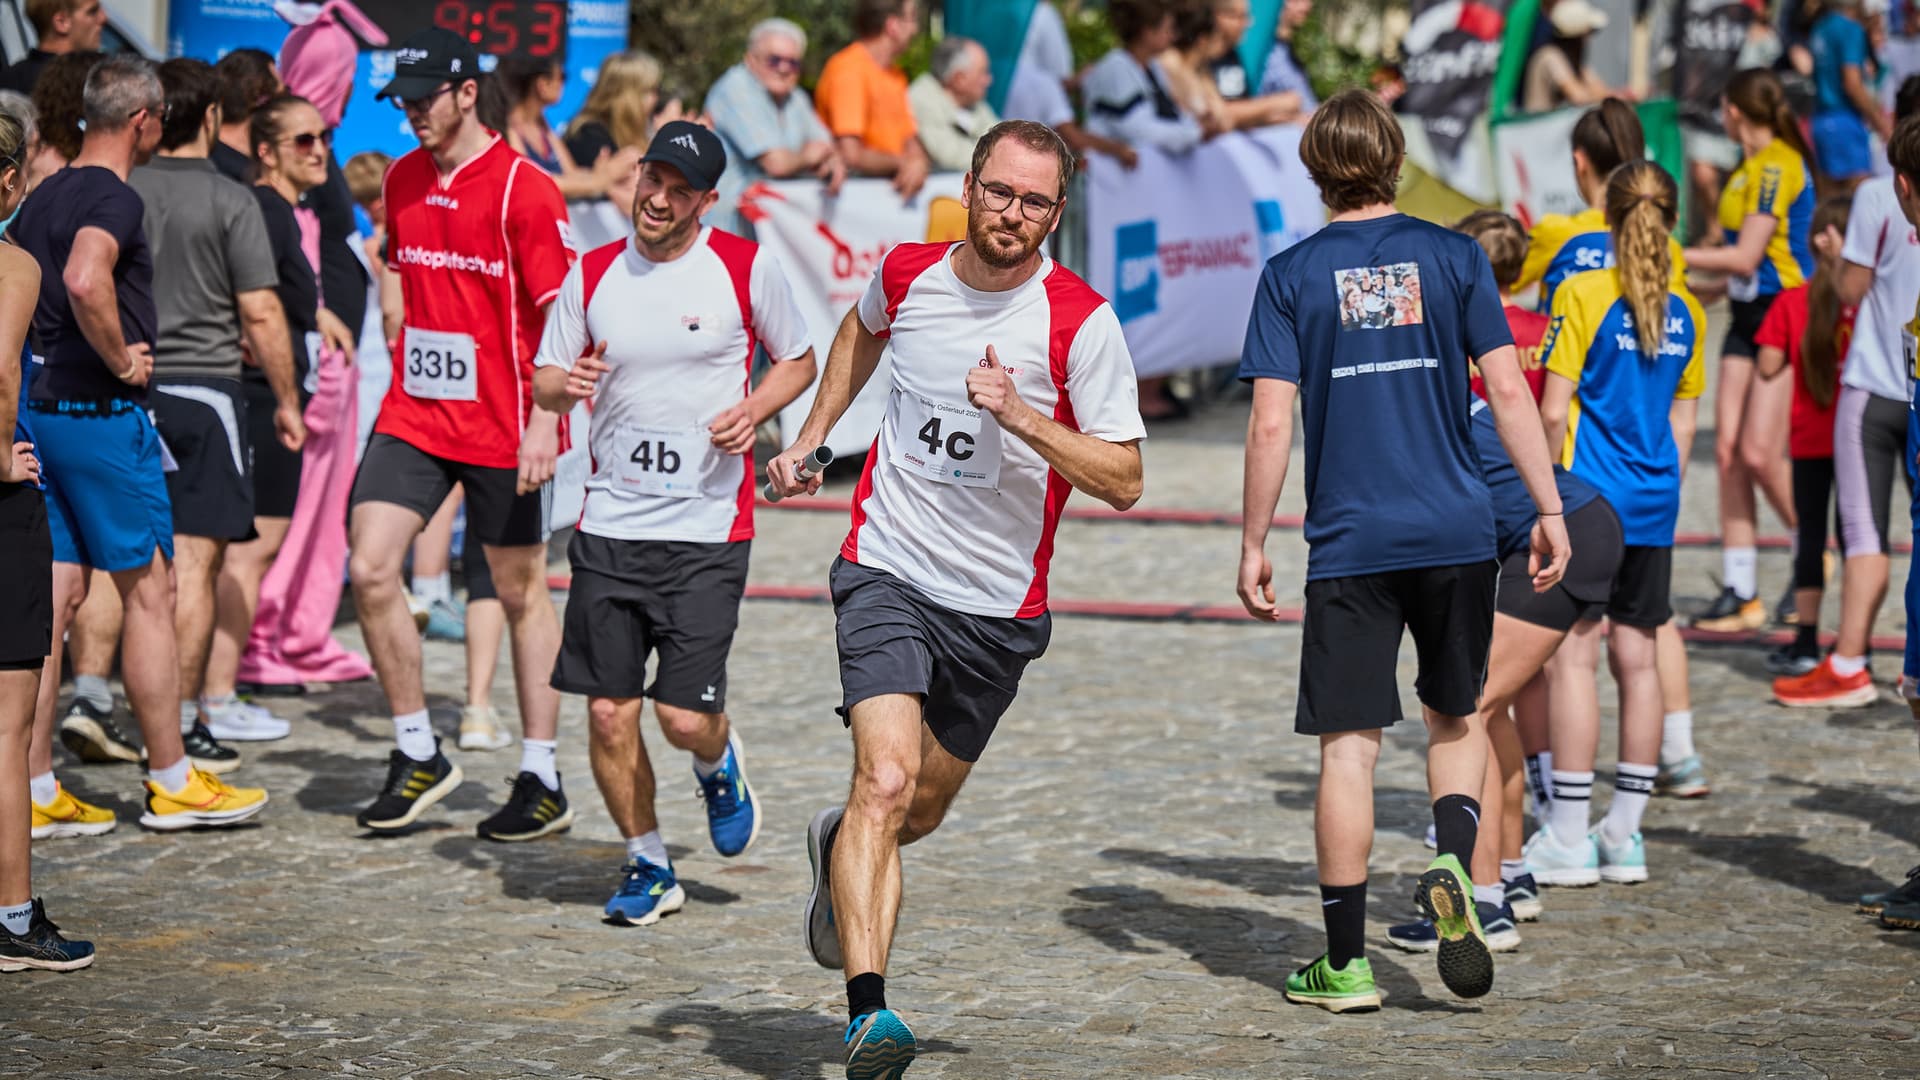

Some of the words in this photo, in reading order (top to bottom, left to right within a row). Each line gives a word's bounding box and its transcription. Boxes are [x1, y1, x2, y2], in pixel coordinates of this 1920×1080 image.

[434, 2, 563, 56] 9:53
[409, 347, 467, 381] 33b
[937, 403, 965, 415] Osterlauf
[965, 410, 981, 419] 2025
[918, 417, 975, 461] 4c
[630, 440, 681, 475] 4b
